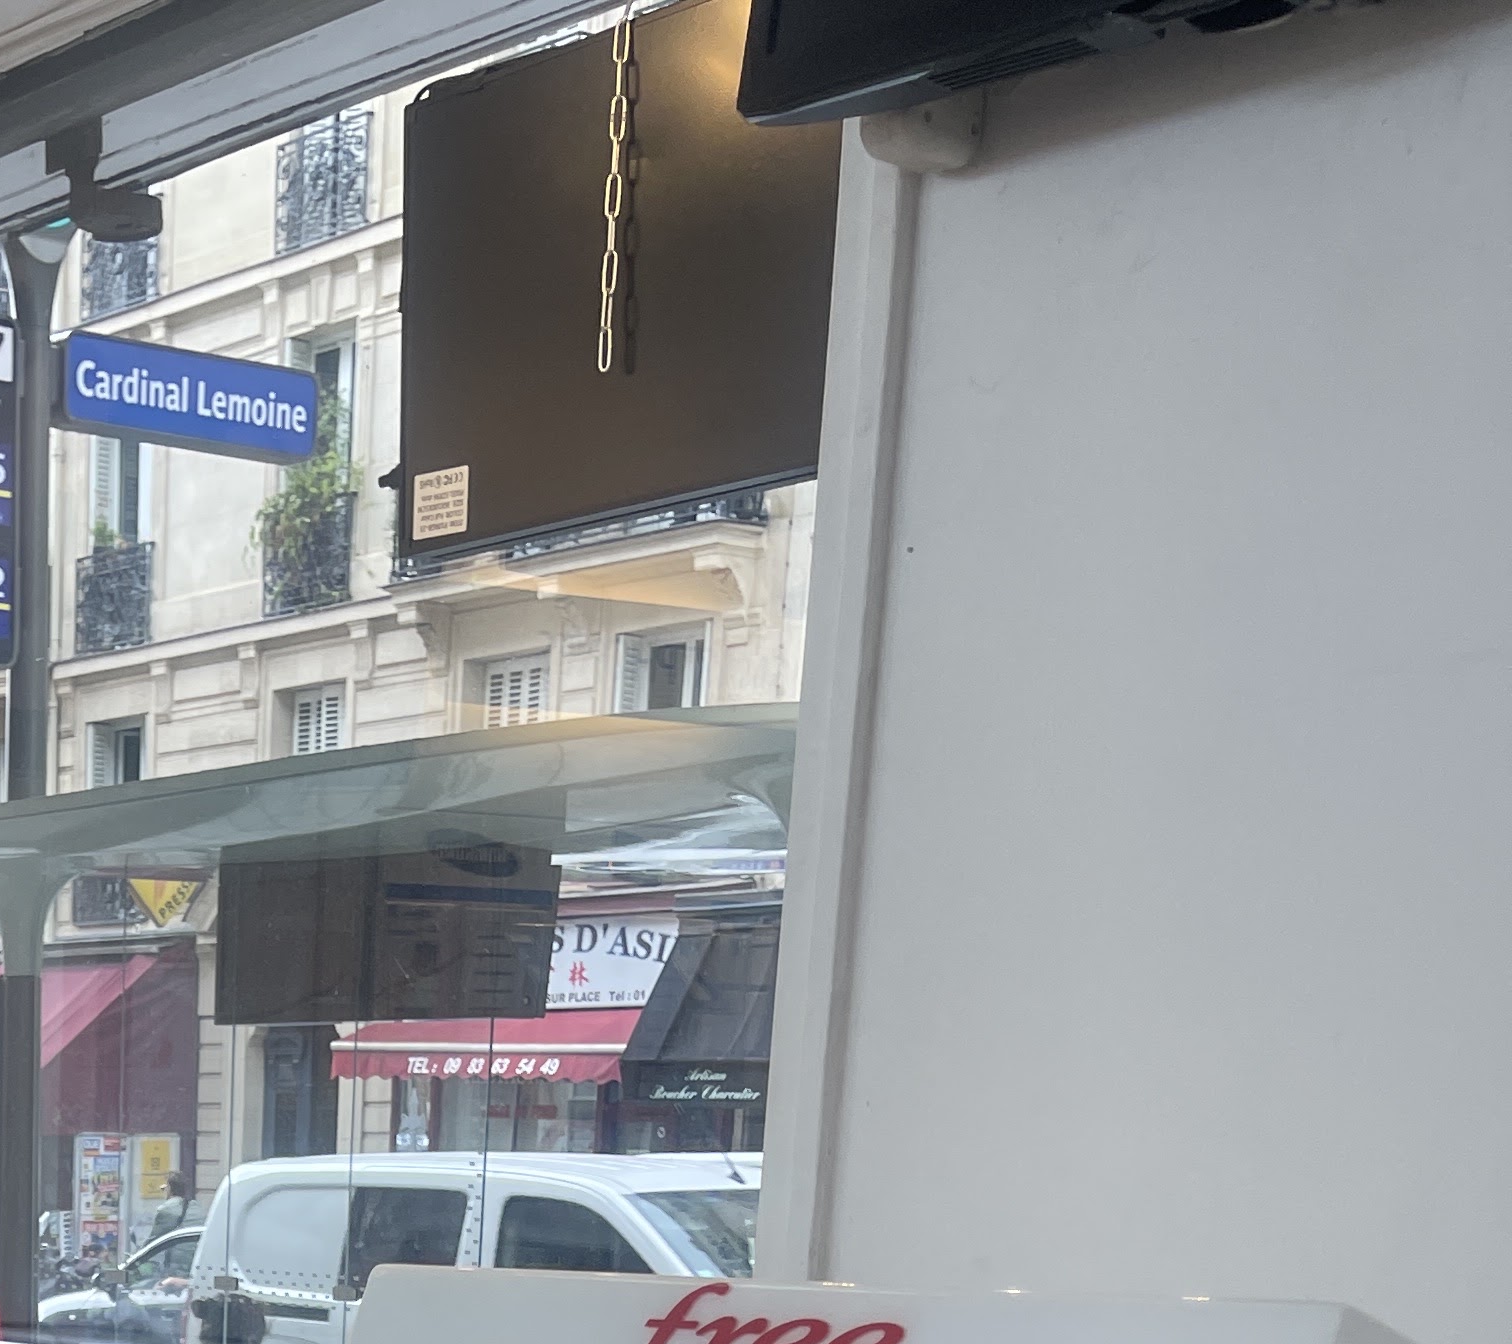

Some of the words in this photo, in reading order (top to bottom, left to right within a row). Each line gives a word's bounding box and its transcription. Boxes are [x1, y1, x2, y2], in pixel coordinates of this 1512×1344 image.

[75, 359, 189, 413] Cardinal
[196, 380, 308, 433] Lemoine
[568, 991, 600, 1003] PLACE
